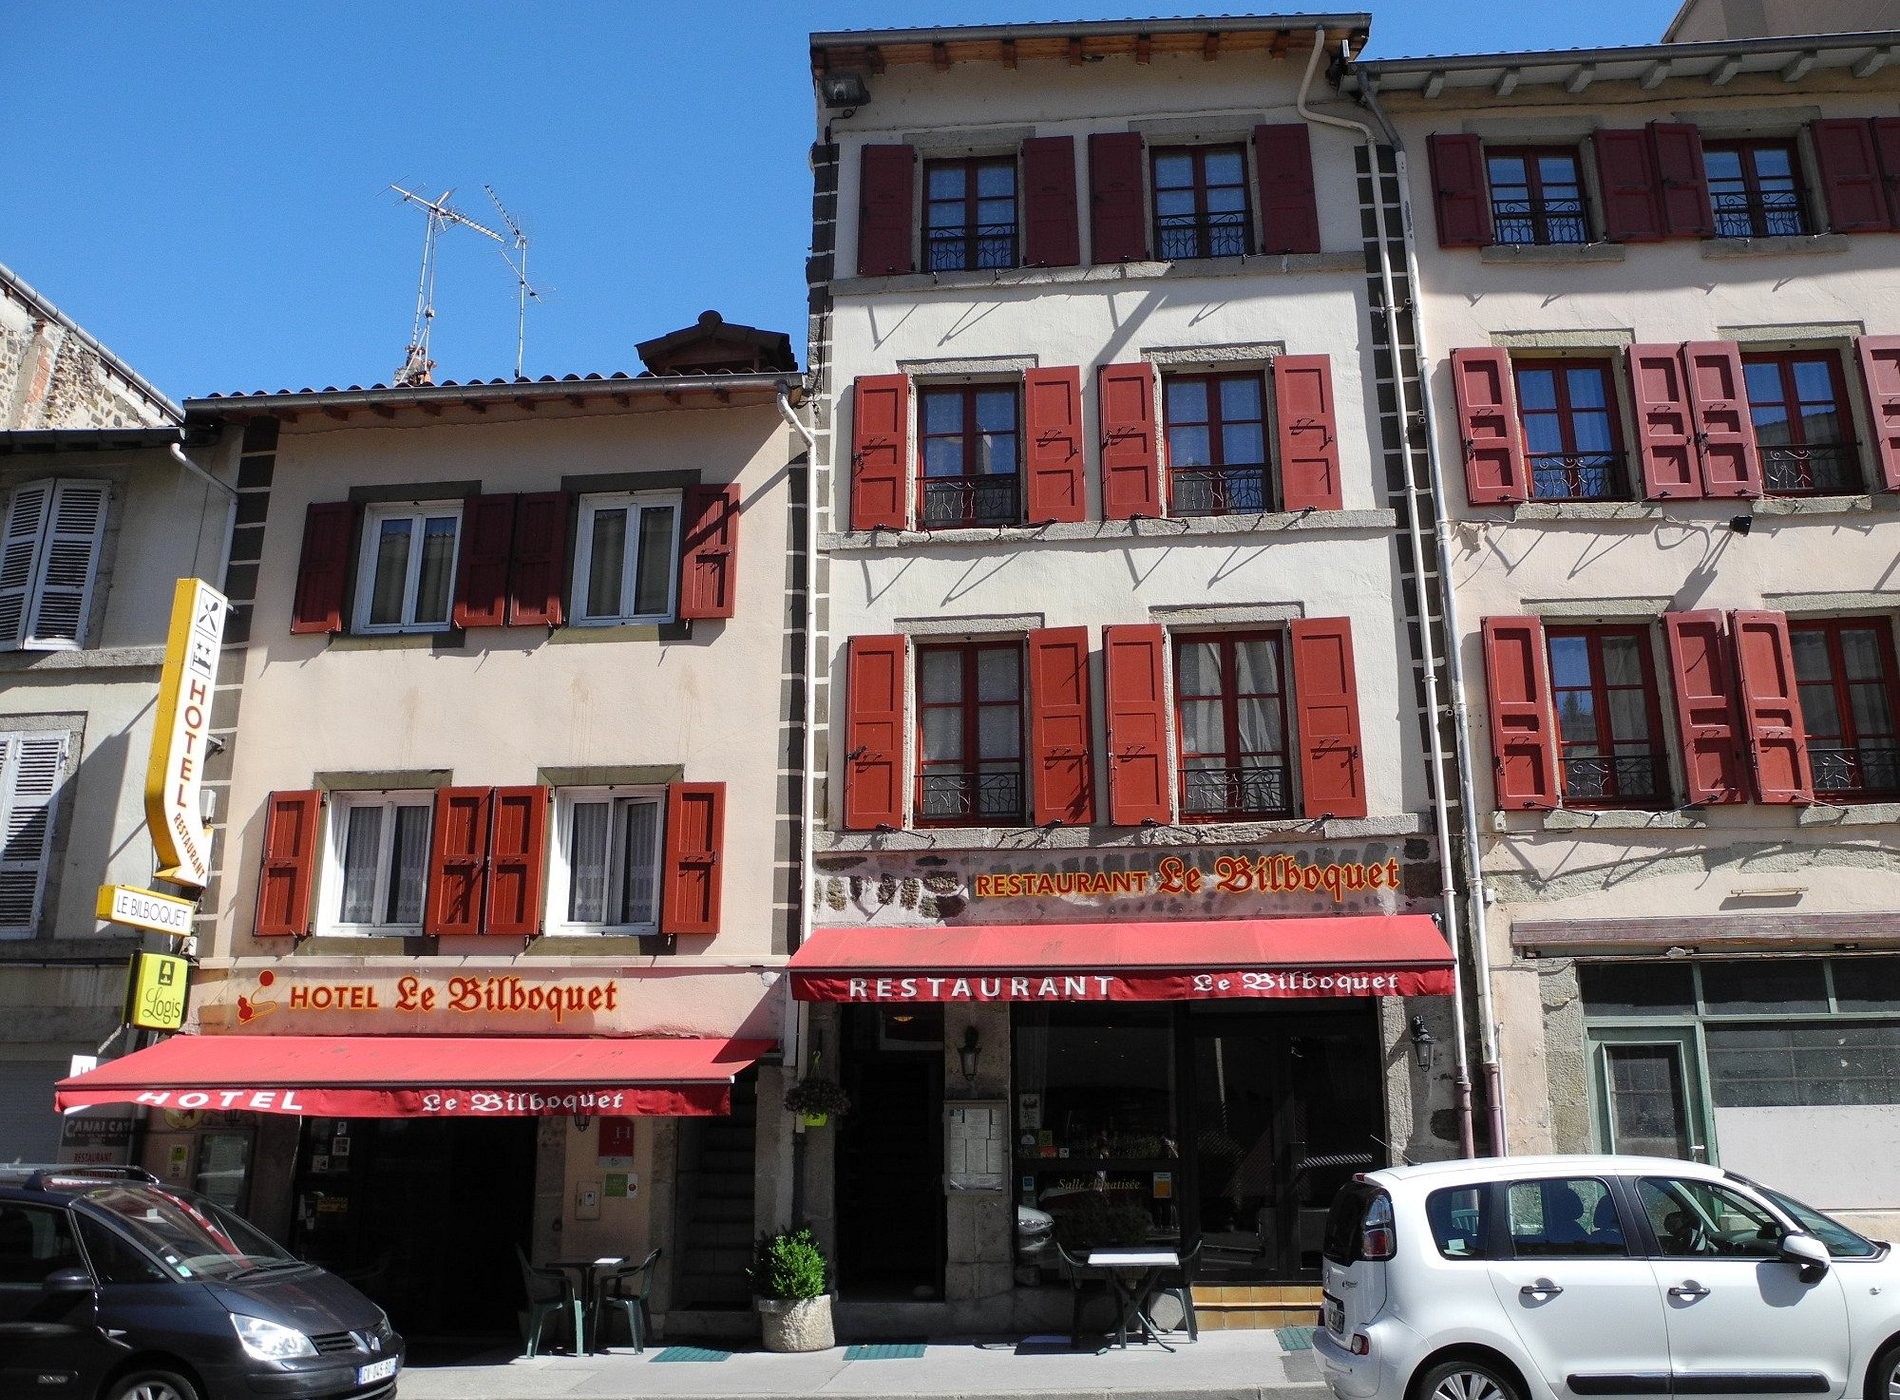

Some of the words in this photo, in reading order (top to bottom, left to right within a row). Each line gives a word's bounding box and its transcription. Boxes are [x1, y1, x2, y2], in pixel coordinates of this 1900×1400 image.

[176, 679, 206, 808] HOTEL
[173, 813, 206, 880] RESTAURANT
[975, 871, 1149, 897] RESTAURANT
[1158, 856, 1200, 894] Le
[1214, 854, 1400, 903] Bilboquet
[116, 895, 128, 915] LE
[130, 898, 187, 927] BILBOQUET
[290, 986, 378, 1009] HOTEL
[395, 975, 435, 1012] Le
[447, 975, 618, 1023] Bilboquet
[848, 975, 1115, 998] RESTAURANT
[1193, 974, 1230, 993] Le
[1241, 971, 1400, 995] Bilboquet
[142, 987, 181, 1024] Logis
[136, 1091, 303, 1111] HOTEL
[422, 1094, 457, 1112] Le
[470, 1092, 625, 1112] Bilboquet
[1057, 1178, 1085, 1190] Salle
